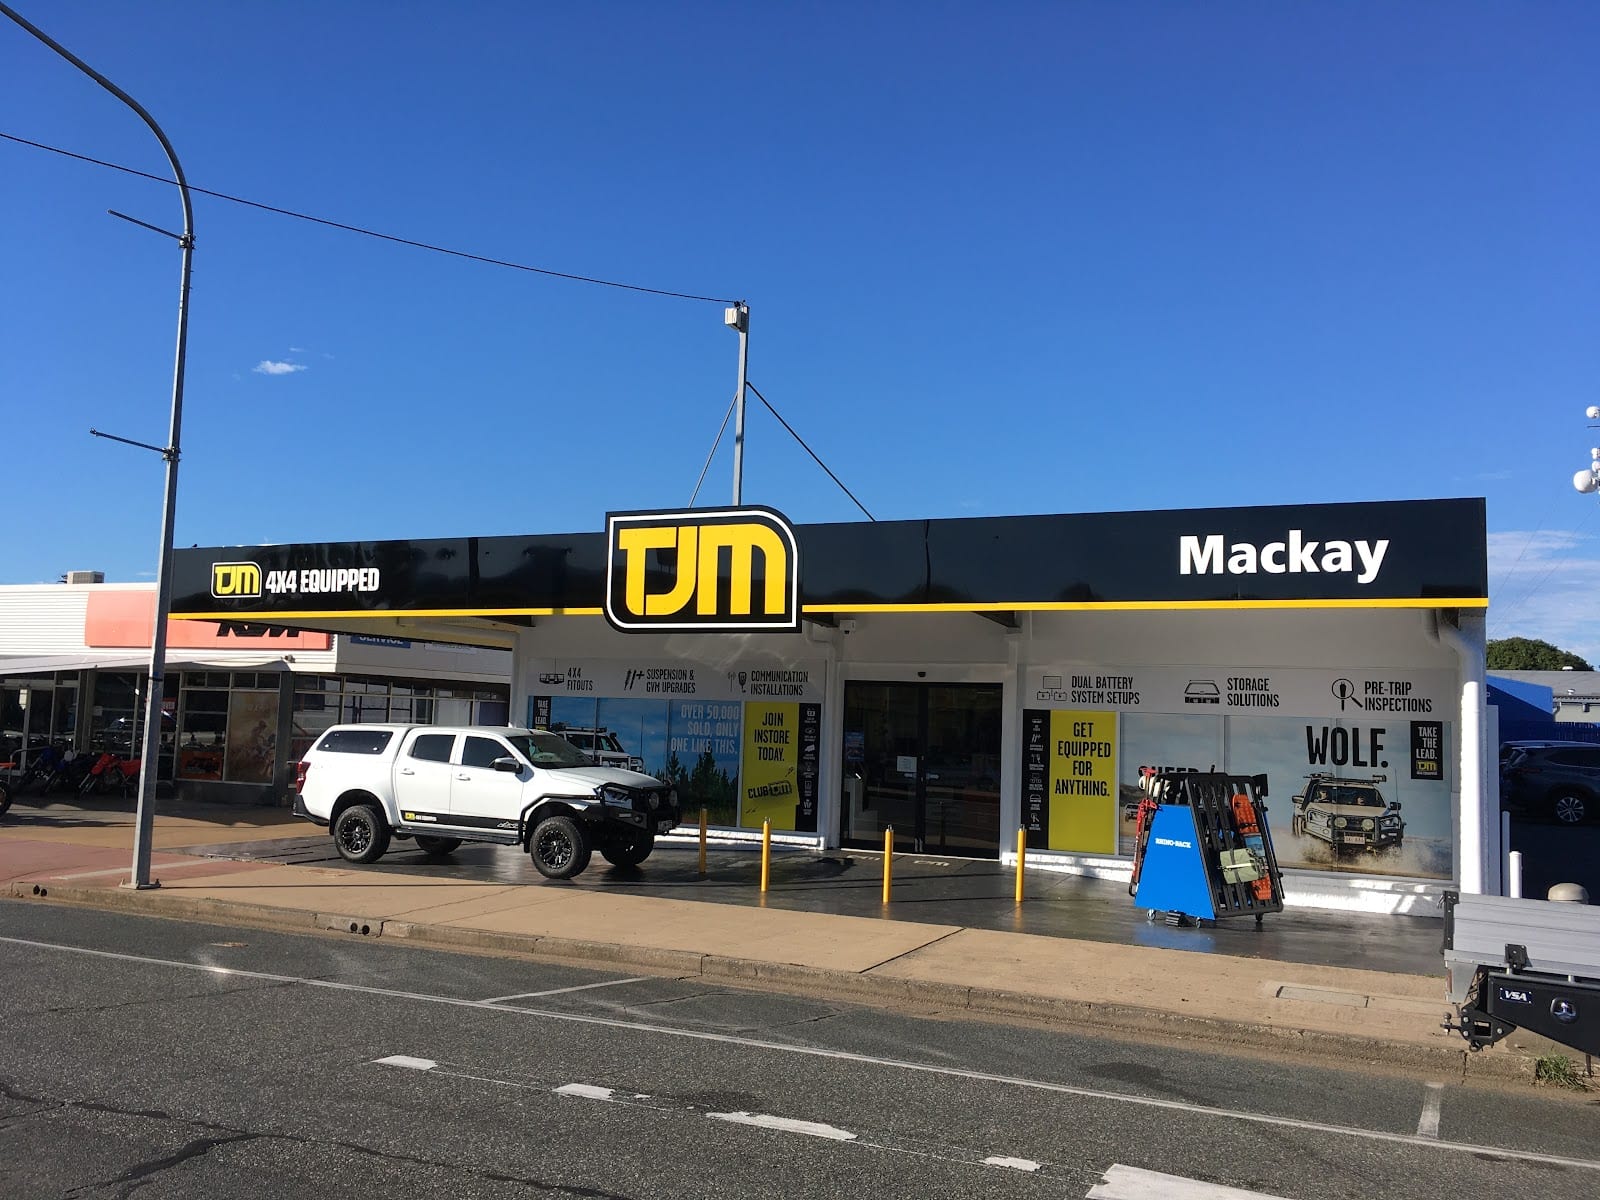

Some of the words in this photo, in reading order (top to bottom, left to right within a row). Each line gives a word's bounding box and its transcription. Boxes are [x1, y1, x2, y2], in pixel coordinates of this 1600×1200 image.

[1179, 529, 1390, 584] Mackay
[619, 523, 786, 615] TJM
[215, 564, 260, 595] TJM
[265, 570, 297, 593] 4X4
[300, 568, 380, 593] EQUIPPED
[567, 667, 582, 679] 4X4
[646, 669, 688, 681] SUSPENSION
[689, 669, 695, 681] &
[751, 670, 809, 683] COMMUNICATION
[566, 679, 594, 691] FITOUTS
[661, 682, 696, 694] UPGRADES
[750, 683, 804, 696] INSTALLATIONS
[1071, 676, 1094, 689] DUAL
[1096, 676, 1134, 690] BATTERY
[1227, 677, 1270, 692] STORAGE
[1364, 681, 1412, 695] PRE-TRIP
[1071, 690, 1105, 704] SYSTEM
[1106, 691, 1140, 705] SETUPS
[1227, 693, 1280, 707] SOLUTIONS
[1364, 697, 1433, 712] INSPECTIONS
[681, 704, 703, 720] OVER
[706, 704, 740, 721] 50,000
[762, 712, 784, 727] JOIN
[687, 721, 713, 738] SOLD,
[715, 722, 740, 738] ONLY
[754, 729, 790, 744] INSTORE
[1073, 722, 1094, 737] GET
[1417, 726, 1438, 737] TAKE
[670, 737, 689, 752] ONE
[691, 738, 712, 753] LIKE
[714, 738, 738, 754] THIS.
[1057, 740, 1111, 758] EQUIPPED
[1306, 726, 1389, 768] WOLF.
[1422, 737, 1438, 748] THE
[758, 746, 785, 761] TODAY.
[1415, 748, 1438, 760] LEAD.
[1072, 760, 1093, 776] FOR
[747, 785, 769, 799] CLUB
[1054, 778, 1110, 797] ANYTHING.
[1504, 990, 1528, 1002] VSA
